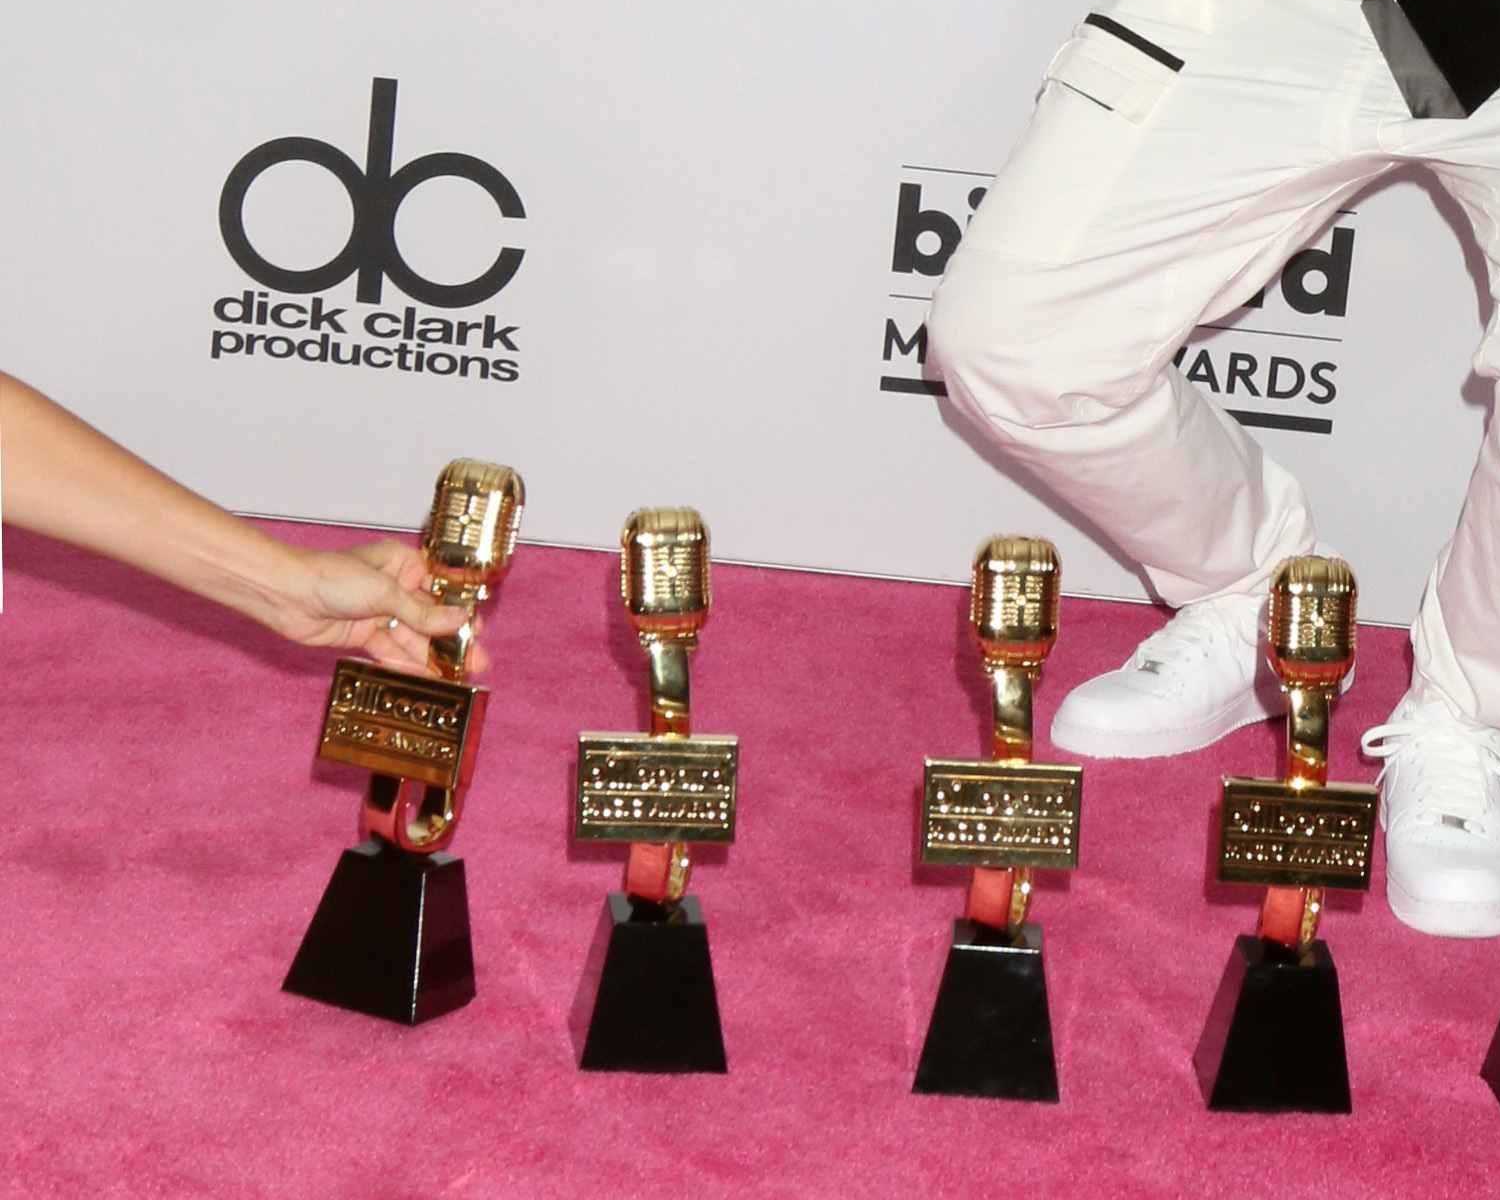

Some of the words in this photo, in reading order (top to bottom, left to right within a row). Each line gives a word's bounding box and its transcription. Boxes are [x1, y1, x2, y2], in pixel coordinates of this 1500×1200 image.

[214, 291, 347, 333] dick
[364, 307, 519, 351] clark
[211, 331, 519, 381] productions
[1174, 347, 1338, 404] ARDS
